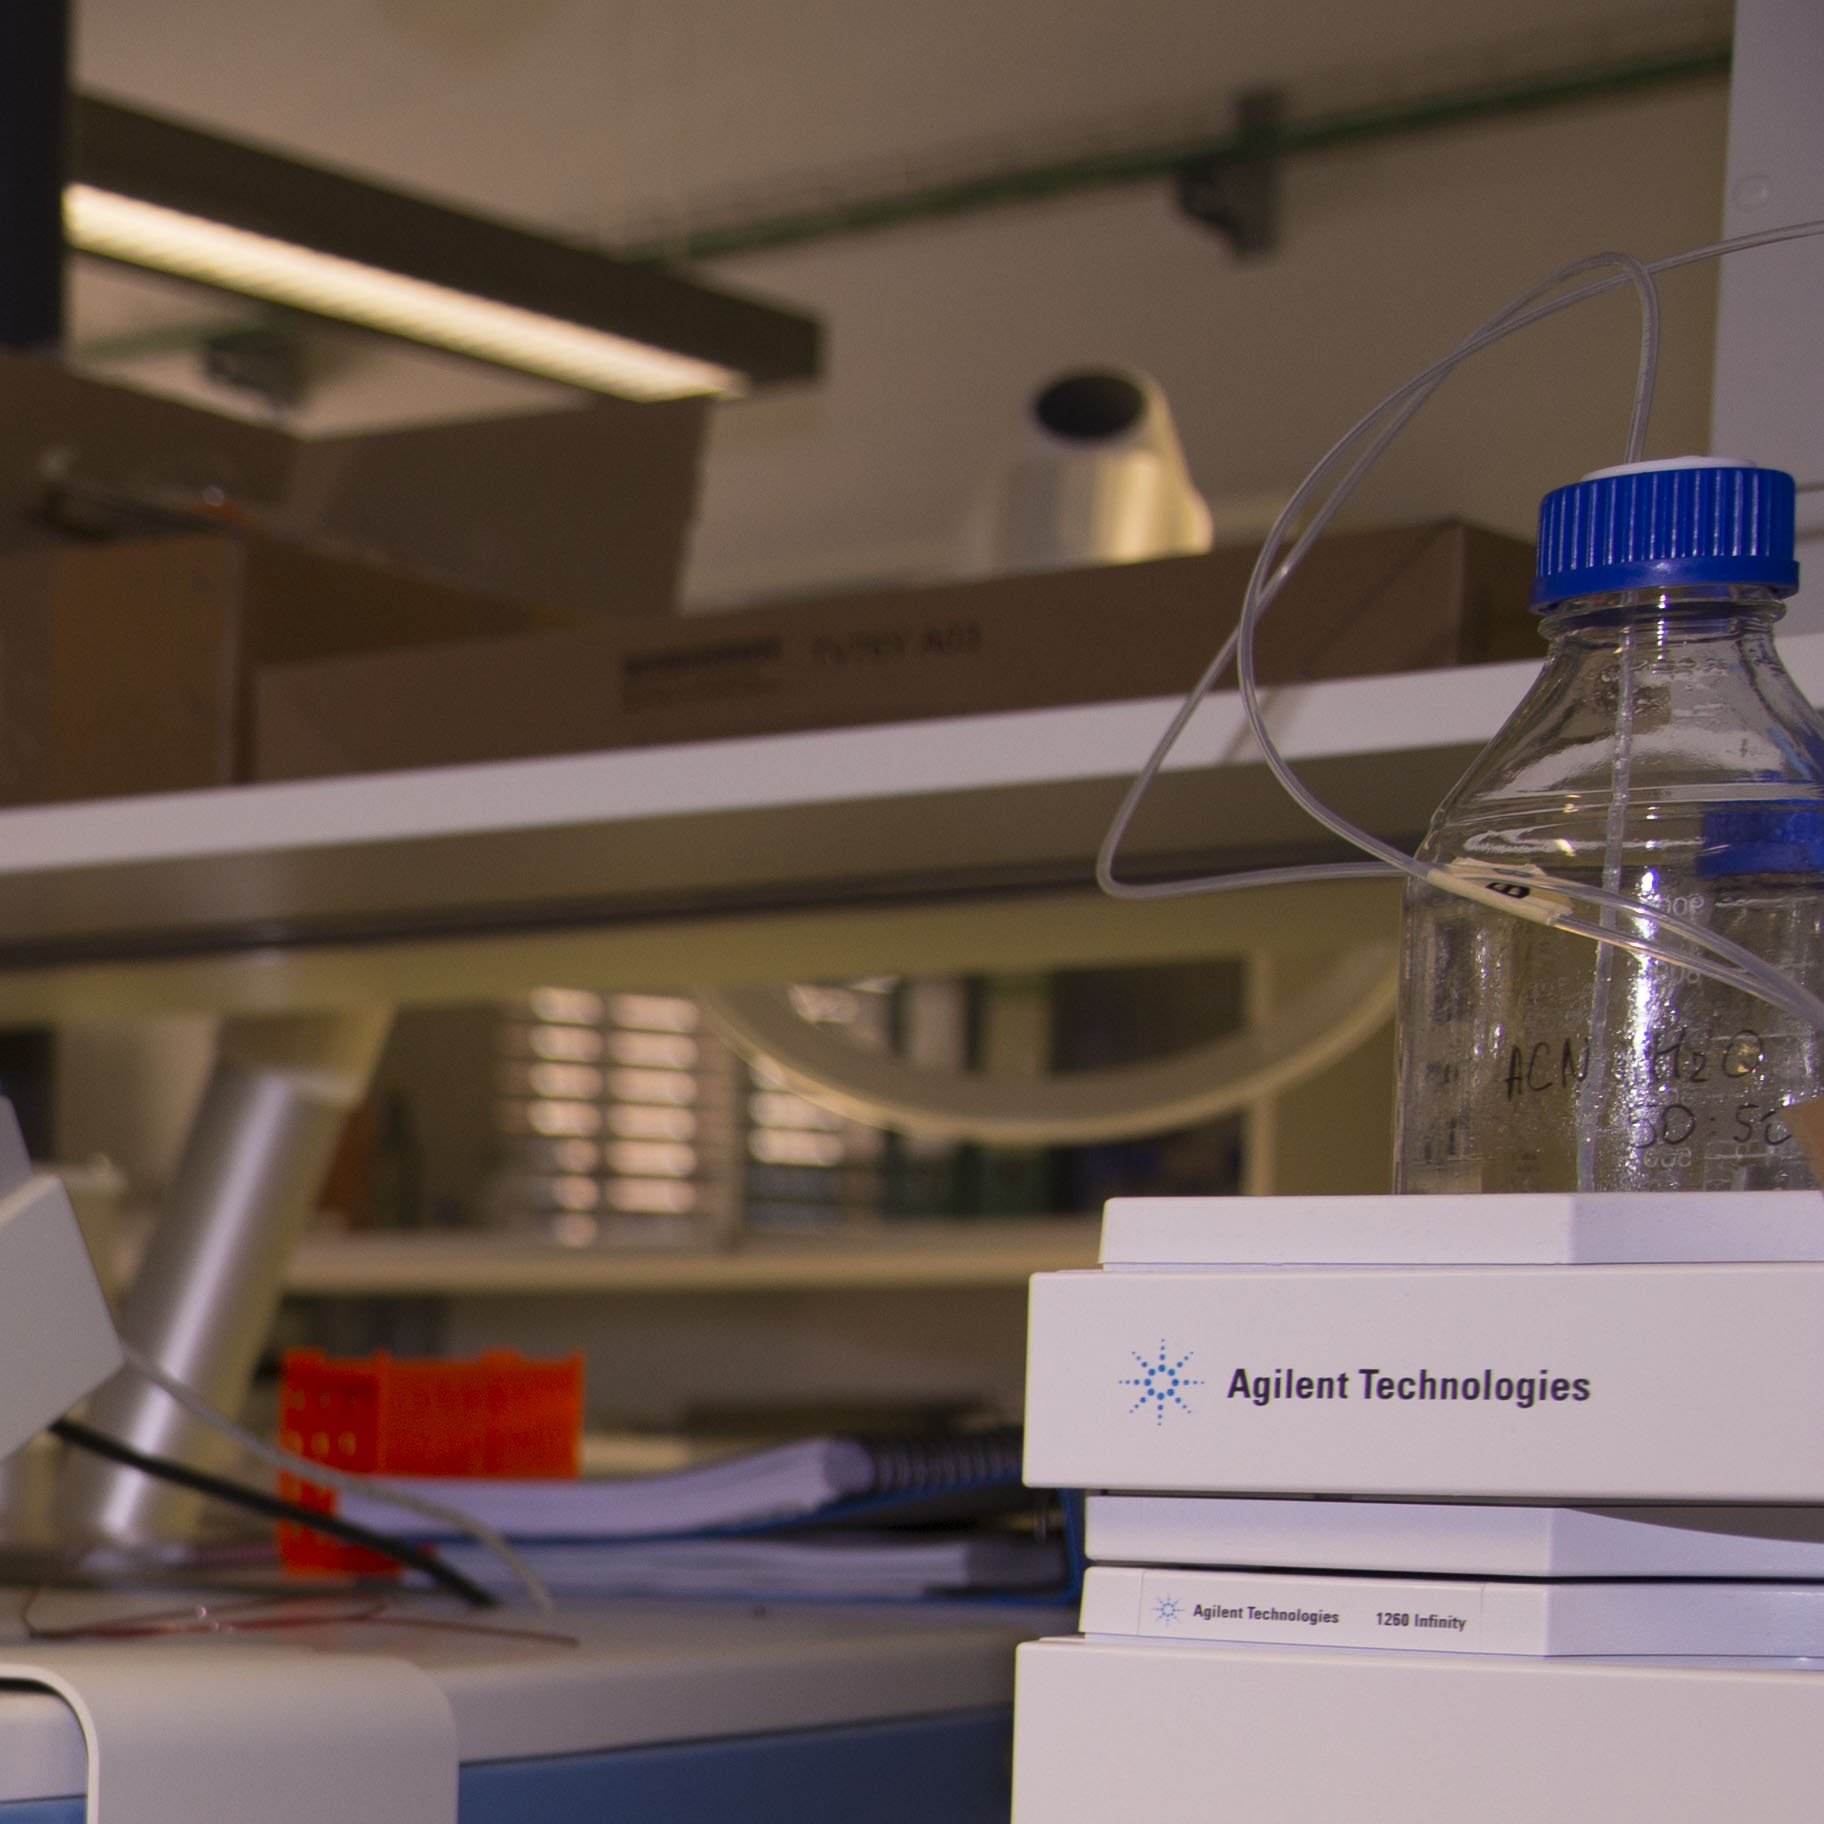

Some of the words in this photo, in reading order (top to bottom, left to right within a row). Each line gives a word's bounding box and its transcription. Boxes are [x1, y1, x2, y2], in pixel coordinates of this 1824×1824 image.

[1227, 1368, 1350, 1407] Agilent
[1358, 1368, 1592, 1409] Technologies
[1192, 1604, 1244, 1621] Agilent
[1247, 1606, 1340, 1626] Technologies
[1376, 1612, 1409, 1627] 1260
[1414, 1613, 1467, 1632] Infinity
